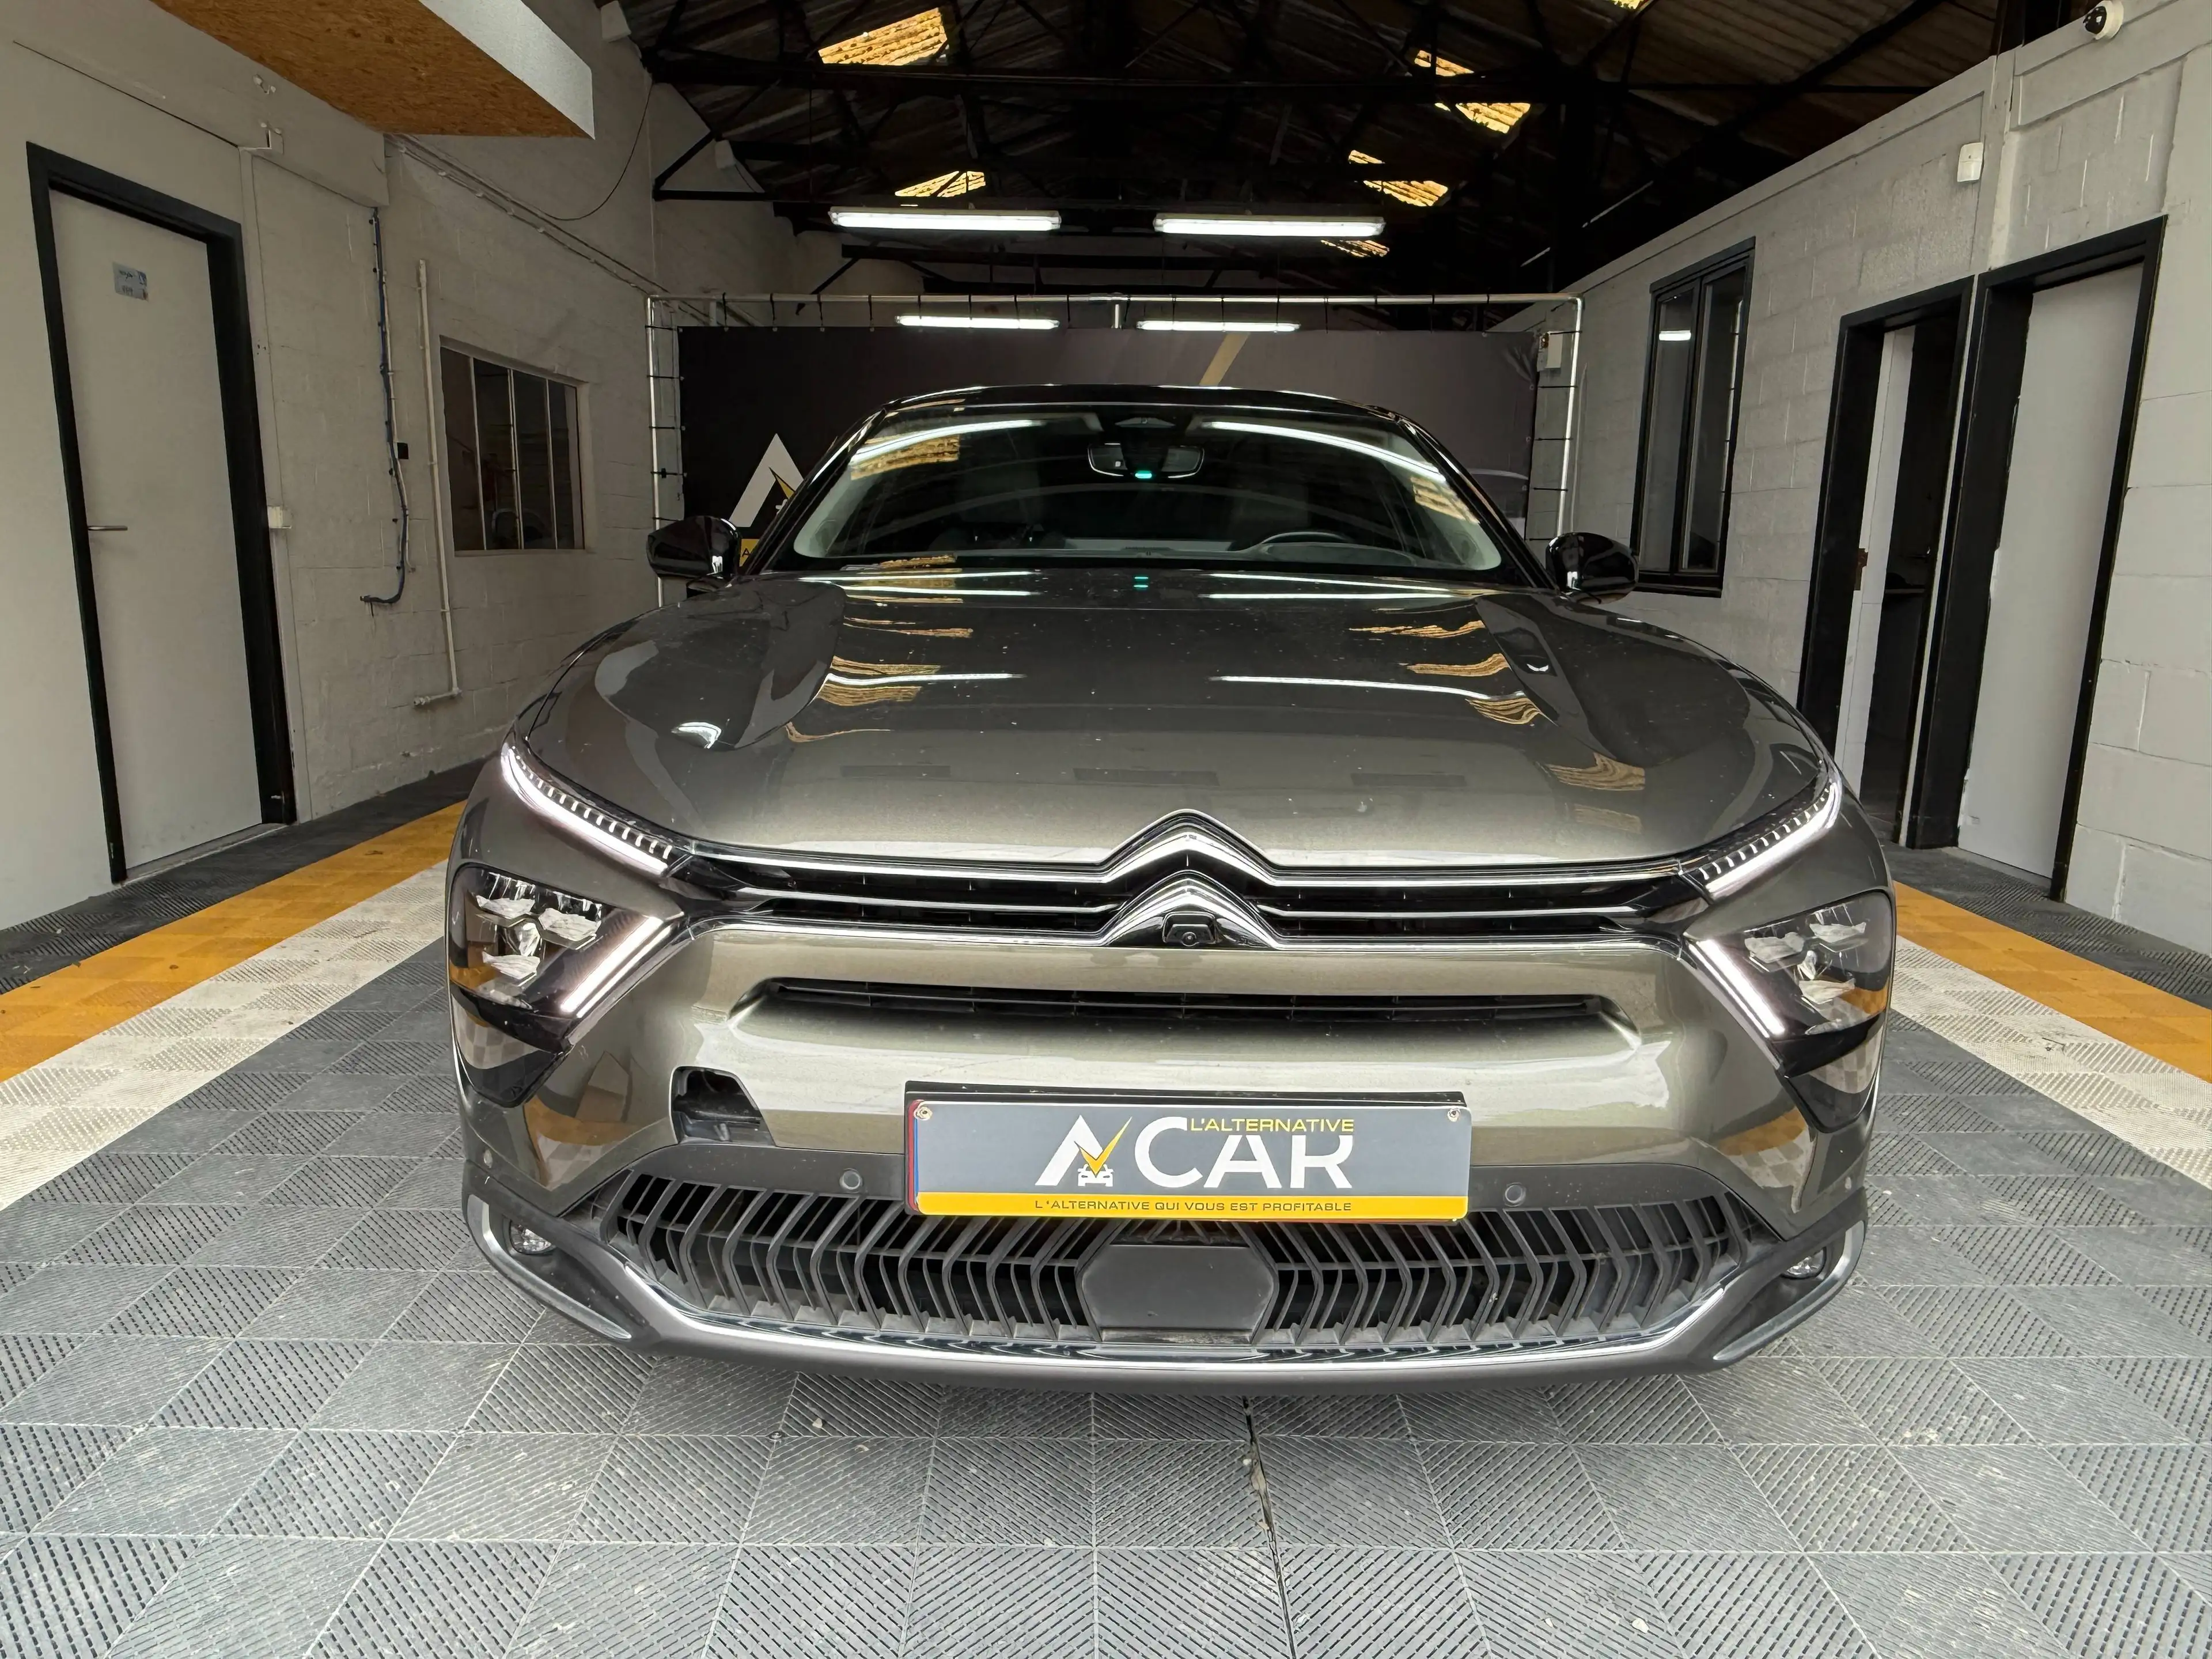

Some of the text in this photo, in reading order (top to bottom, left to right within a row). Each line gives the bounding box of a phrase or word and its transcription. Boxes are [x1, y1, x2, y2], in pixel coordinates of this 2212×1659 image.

[1191, 1118, 1355, 1132] L'ALTERNATIVE
[1035, 1200, 1352, 1211] L'ALTERNATIVE QUI VOUS EST PROFITABLE
